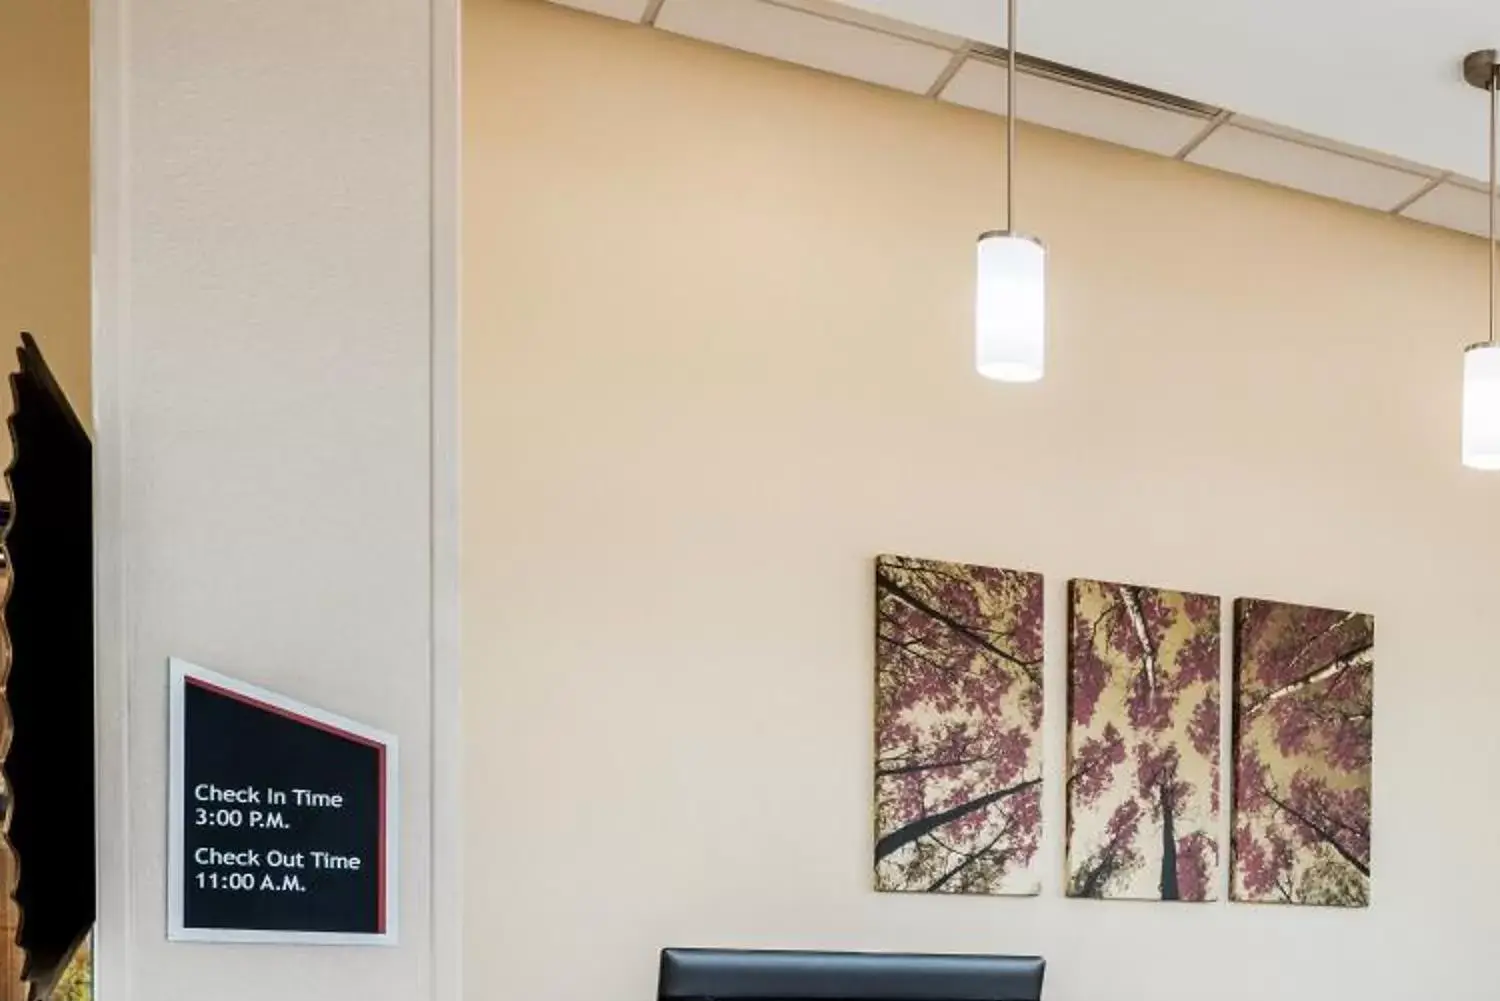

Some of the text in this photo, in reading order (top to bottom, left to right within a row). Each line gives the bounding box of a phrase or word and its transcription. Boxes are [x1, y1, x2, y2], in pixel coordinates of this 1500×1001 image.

[194, 784, 343, 808] Check In Time
[194, 808, 291, 829] 3:00 P.M.
[194, 847, 362, 870] Check Out Time
[194, 872, 307, 893] 11:00 A.M.
